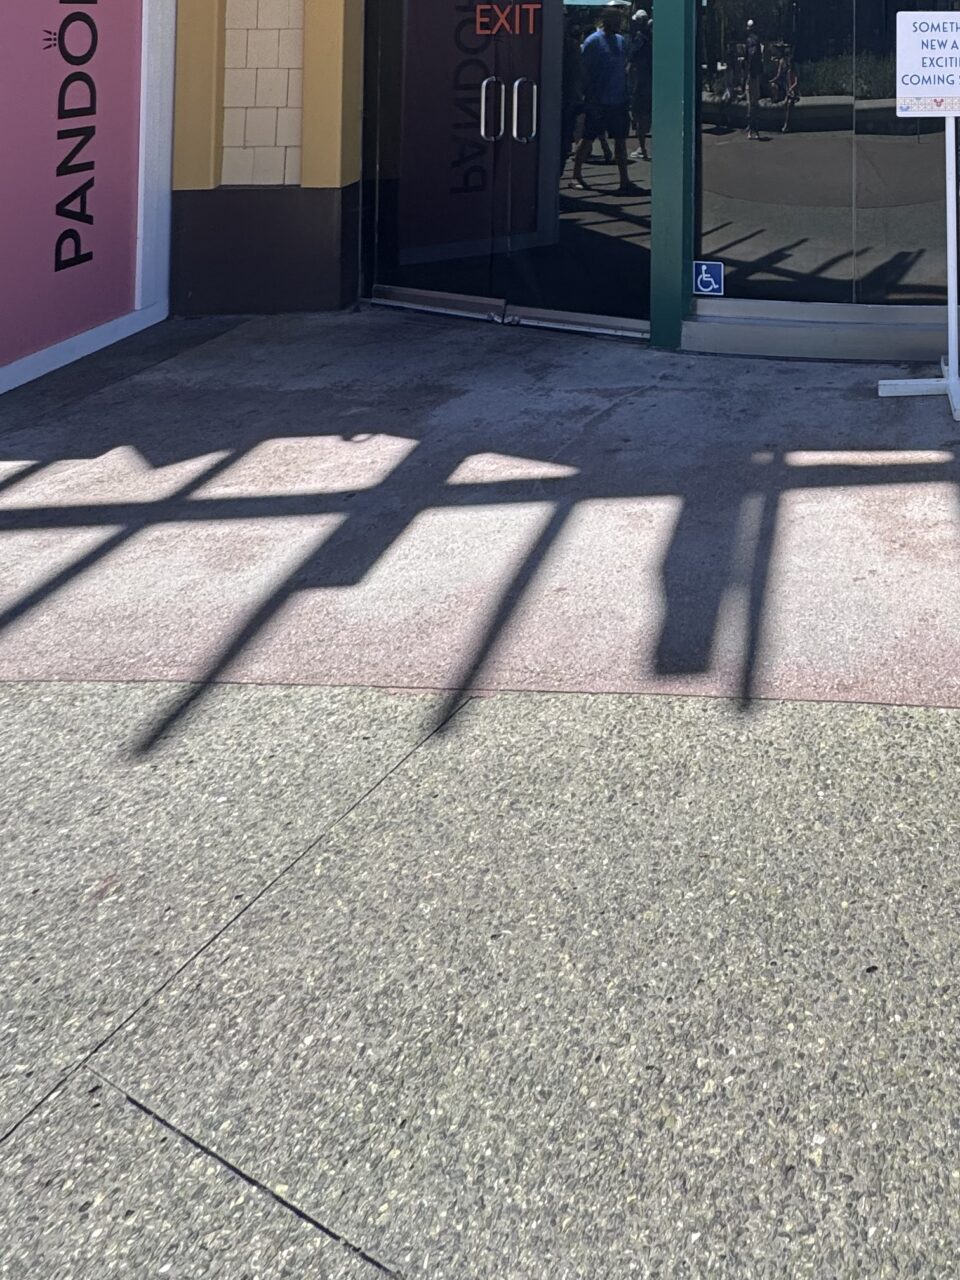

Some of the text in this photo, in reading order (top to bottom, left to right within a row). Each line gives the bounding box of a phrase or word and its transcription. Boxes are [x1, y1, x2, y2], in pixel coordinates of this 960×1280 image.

[476, 4, 542, 35] EXIT
[921, 39, 948, 50] NEW
[901, 74, 955, 86] COMING
